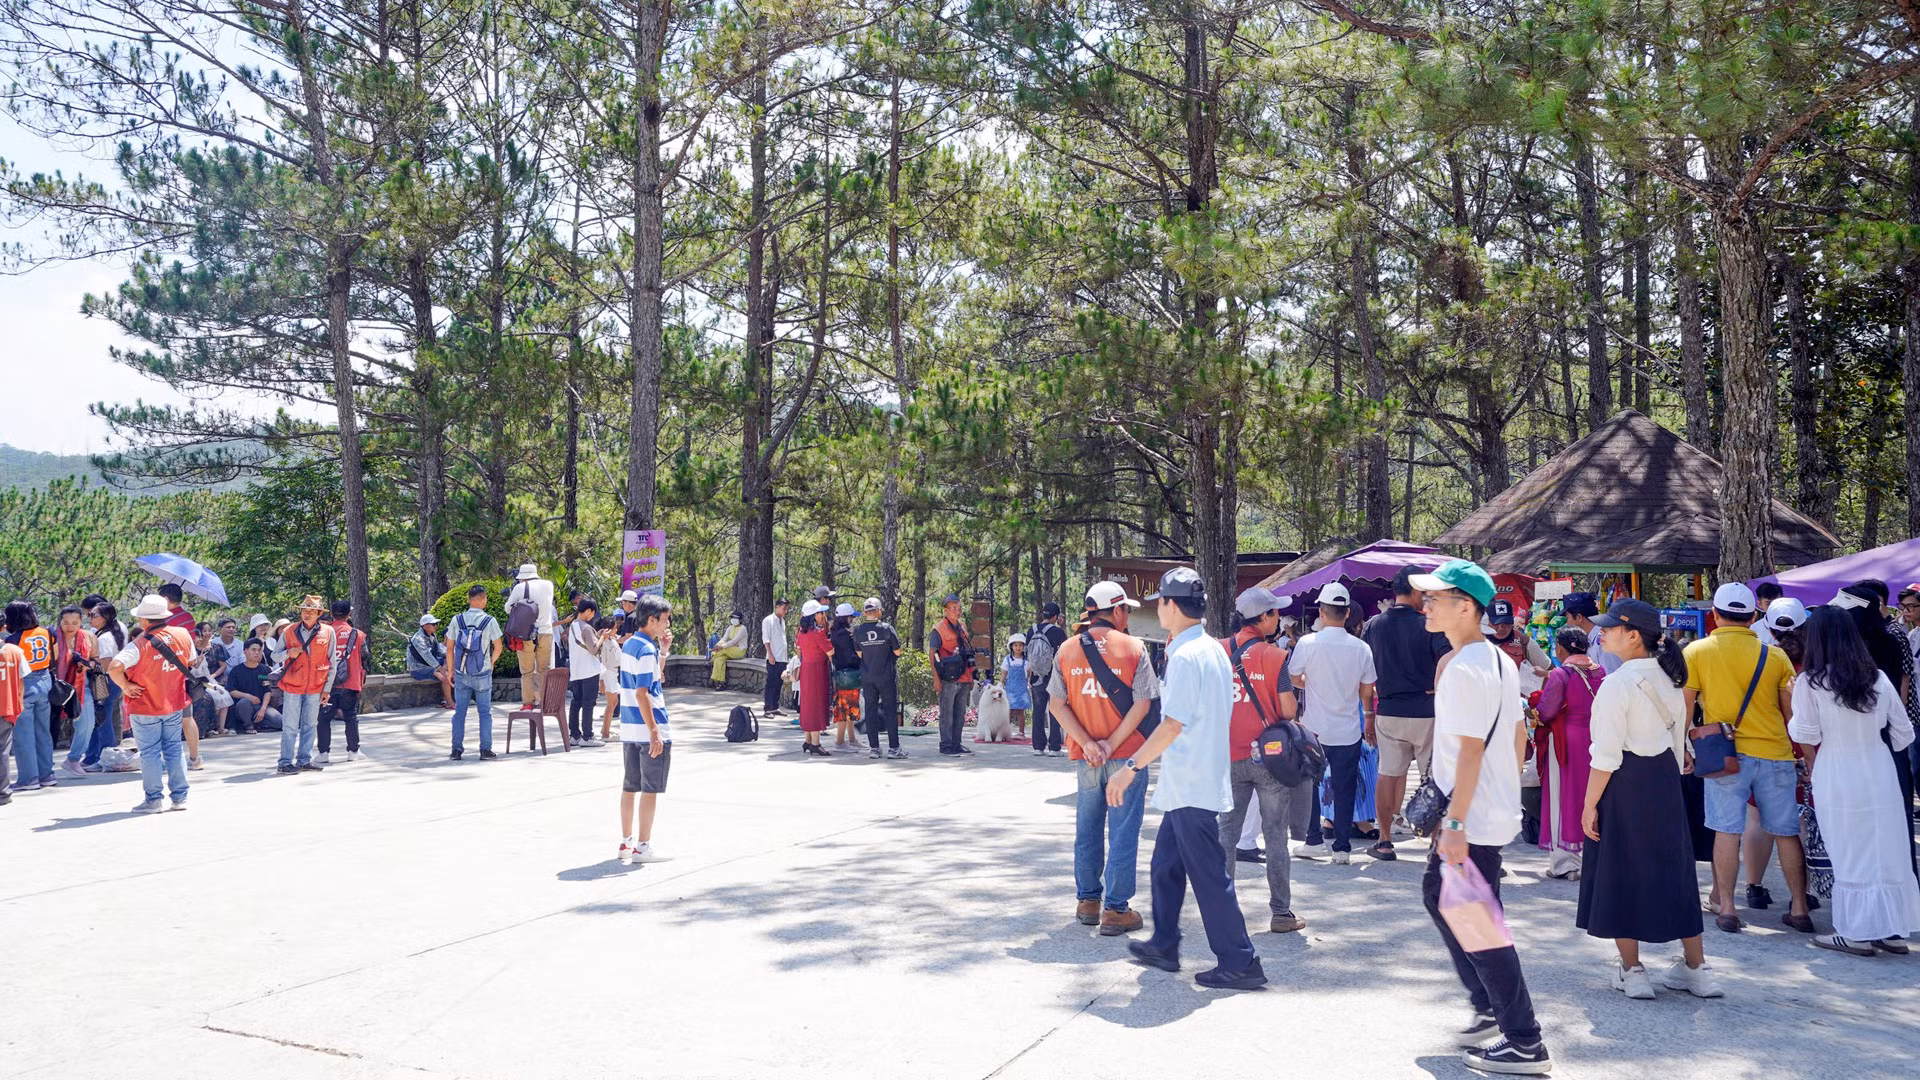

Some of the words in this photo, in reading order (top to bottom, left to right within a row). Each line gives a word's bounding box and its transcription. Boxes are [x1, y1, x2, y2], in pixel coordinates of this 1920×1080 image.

[1676, 618, 1697, 628] pepsi
[866, 630, 878, 641] D
[24, 635, 49, 664] B
